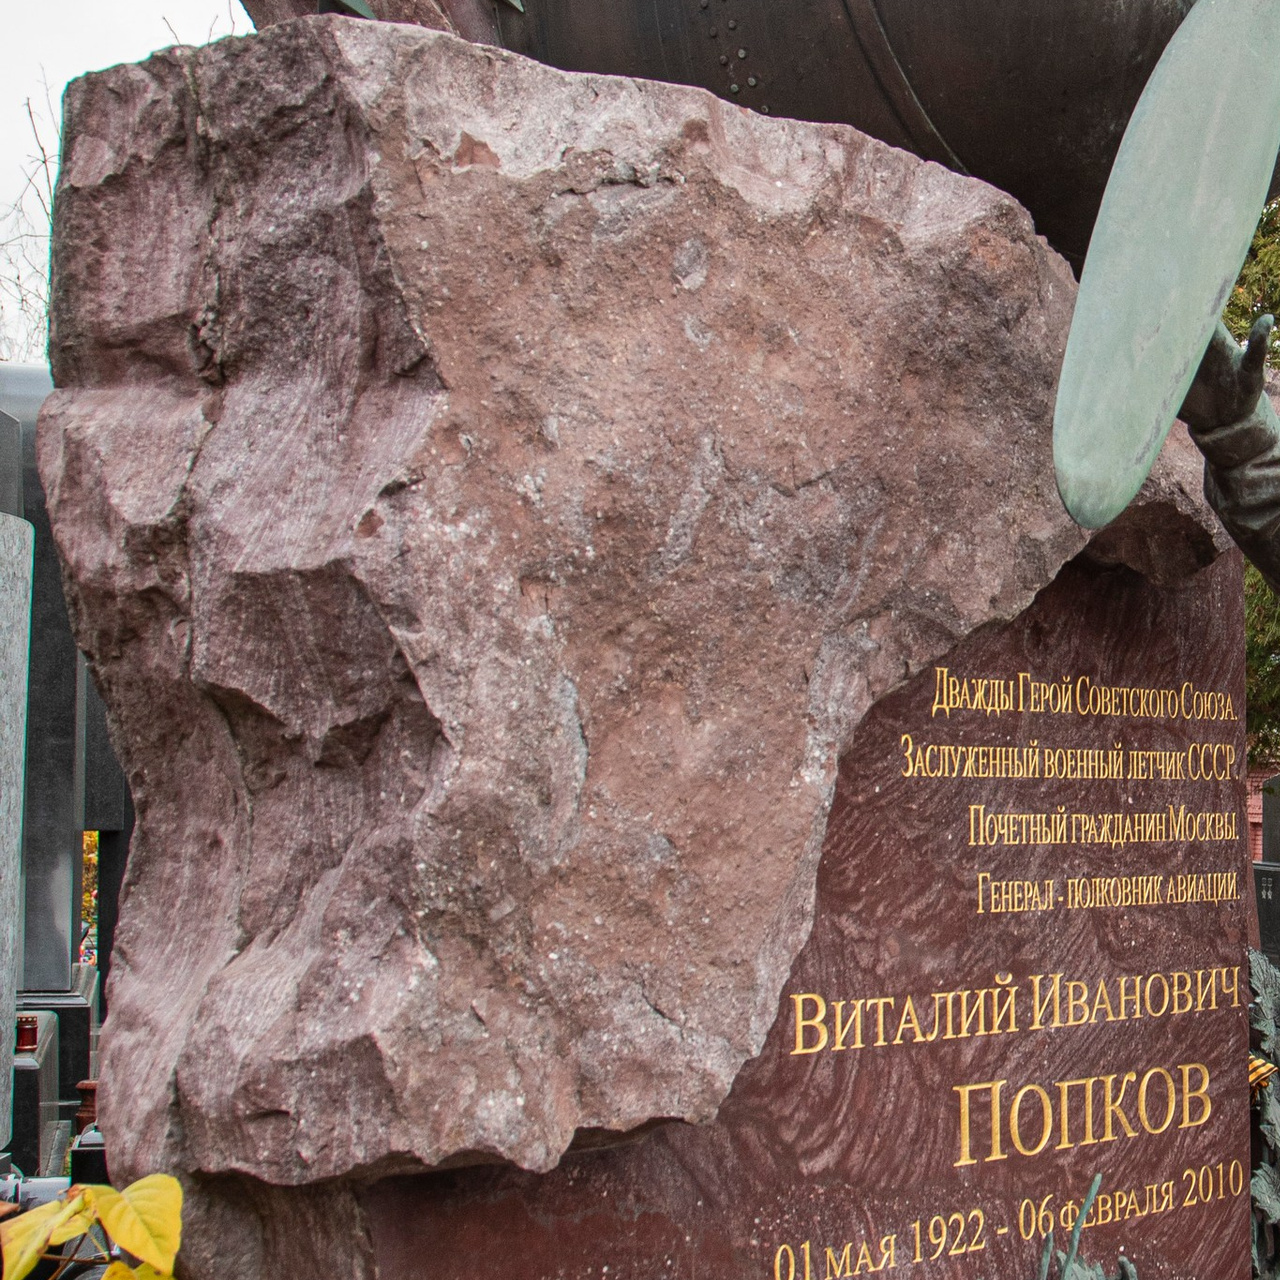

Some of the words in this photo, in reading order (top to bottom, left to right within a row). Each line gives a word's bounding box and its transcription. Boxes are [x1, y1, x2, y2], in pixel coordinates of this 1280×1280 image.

[931, 666, 1015, 719] ДВАЖДЫ
[1017, 672, 1074, 714] ГЕРОЙ
[1076, 676, 1179, 719] СОВЕТСКОГО
[1180, 681, 1238, 721] СОЮЗА.
[900, 733, 1041, 778] ЗАСЛУЖЕННЫЙ
[1043, 741, 1124, 780] ВОЕННЫЙ
[1126, 750, 1187, 781] ЛЕТЧИК
[968, 804, 1068, 846] ПОЧЕТНЫЙ
[1070, 813, 1166, 851] ГРАЖДАНИН
[1167, 804, 1239, 842] МОСКВЫ.
[976, 872, 1054, 914] ГЕНЕРАЛ
[1066, 875, 1164, 909] ПОЛКОВНИК
[1165, 872, 1241, 907] АВИАЦИИ.
[789, 972, 1020, 1056] ВИТАЛИЙ
[1028, 966, 1242, 1032] ИВАНОВИЧ
[952, 1062, 1213, 1168] ПОПКОВ
[909, 1208, 987, 1264] 1922
[1018, 1193, 1055, 1241] 06
[1059, 1180, 1175, 1232] ФЕВРАЛЯ
[1183, 1159, 1244, 1208] 2010
